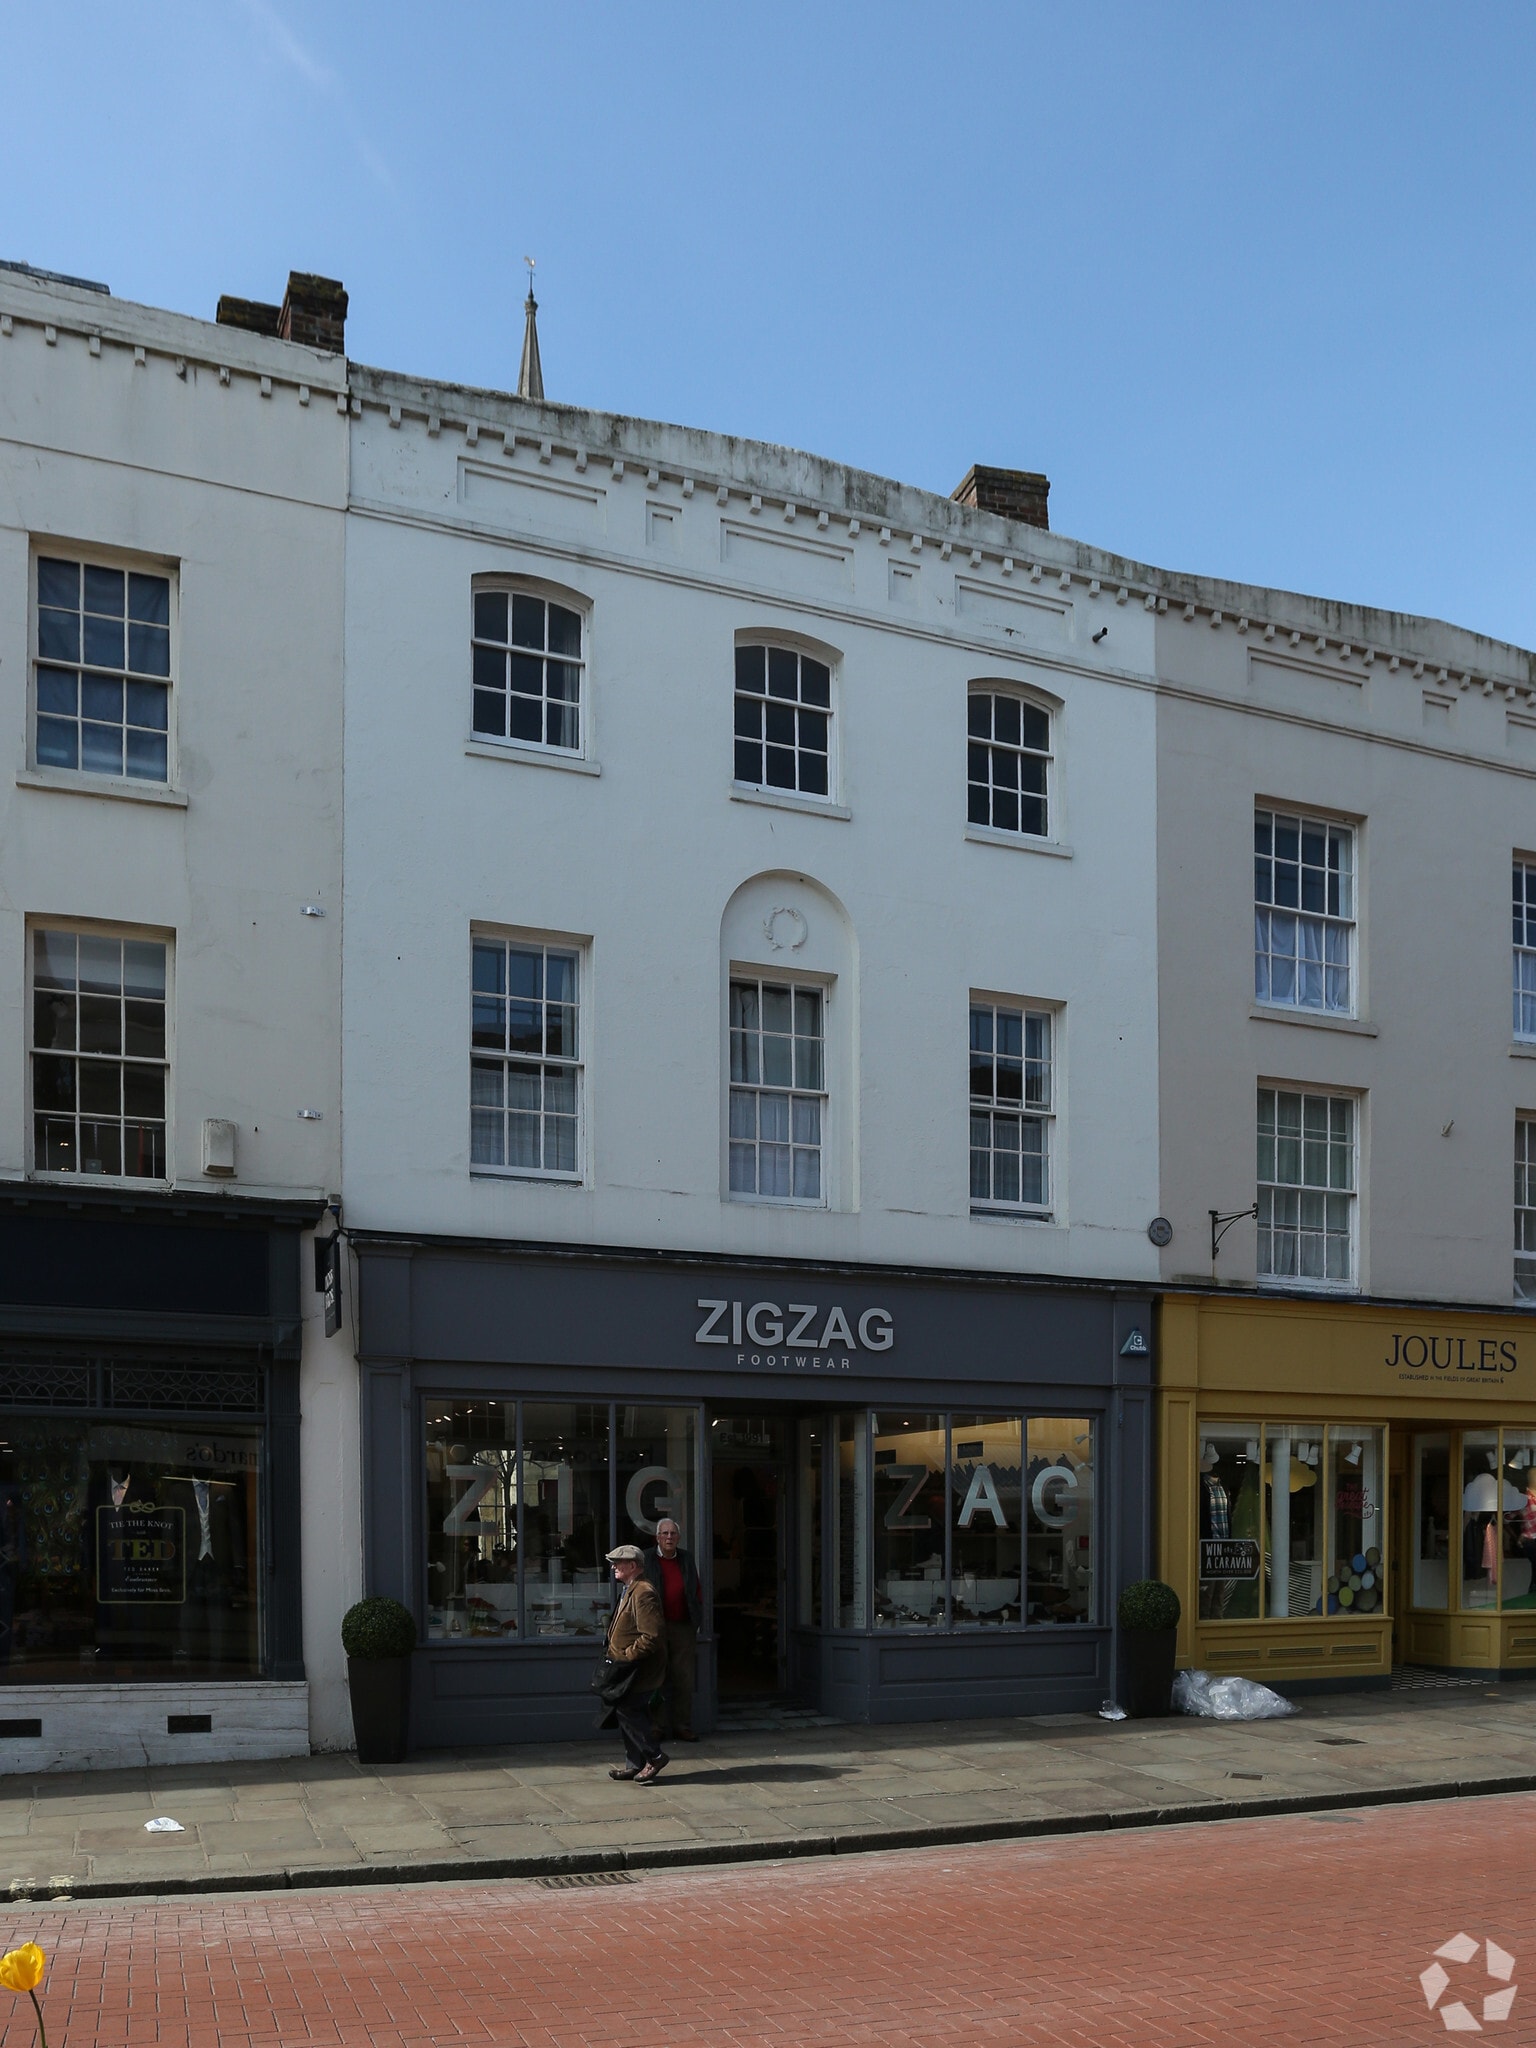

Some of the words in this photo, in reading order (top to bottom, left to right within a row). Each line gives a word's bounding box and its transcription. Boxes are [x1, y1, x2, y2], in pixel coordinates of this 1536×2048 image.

[696, 1299, 894, 1351] ZIGZAG
[1385, 1334, 1517, 1372] JOULES
[737, 1354, 850, 1369] FOOTWEAR
[1398, 1373, 1429, 1381] ESTABLISHED
[110, 1520, 125, 1529] TIE
[127, 1520, 145, 1528] THE
[147, 1520, 175, 1530] KNOT
[108, 1539, 176, 1560] TED
[1206, 1543, 1223, 1556] WIN
[1206, 1556, 1212, 1569] A
[1214, 1556, 1252, 1569] CARAVAN
